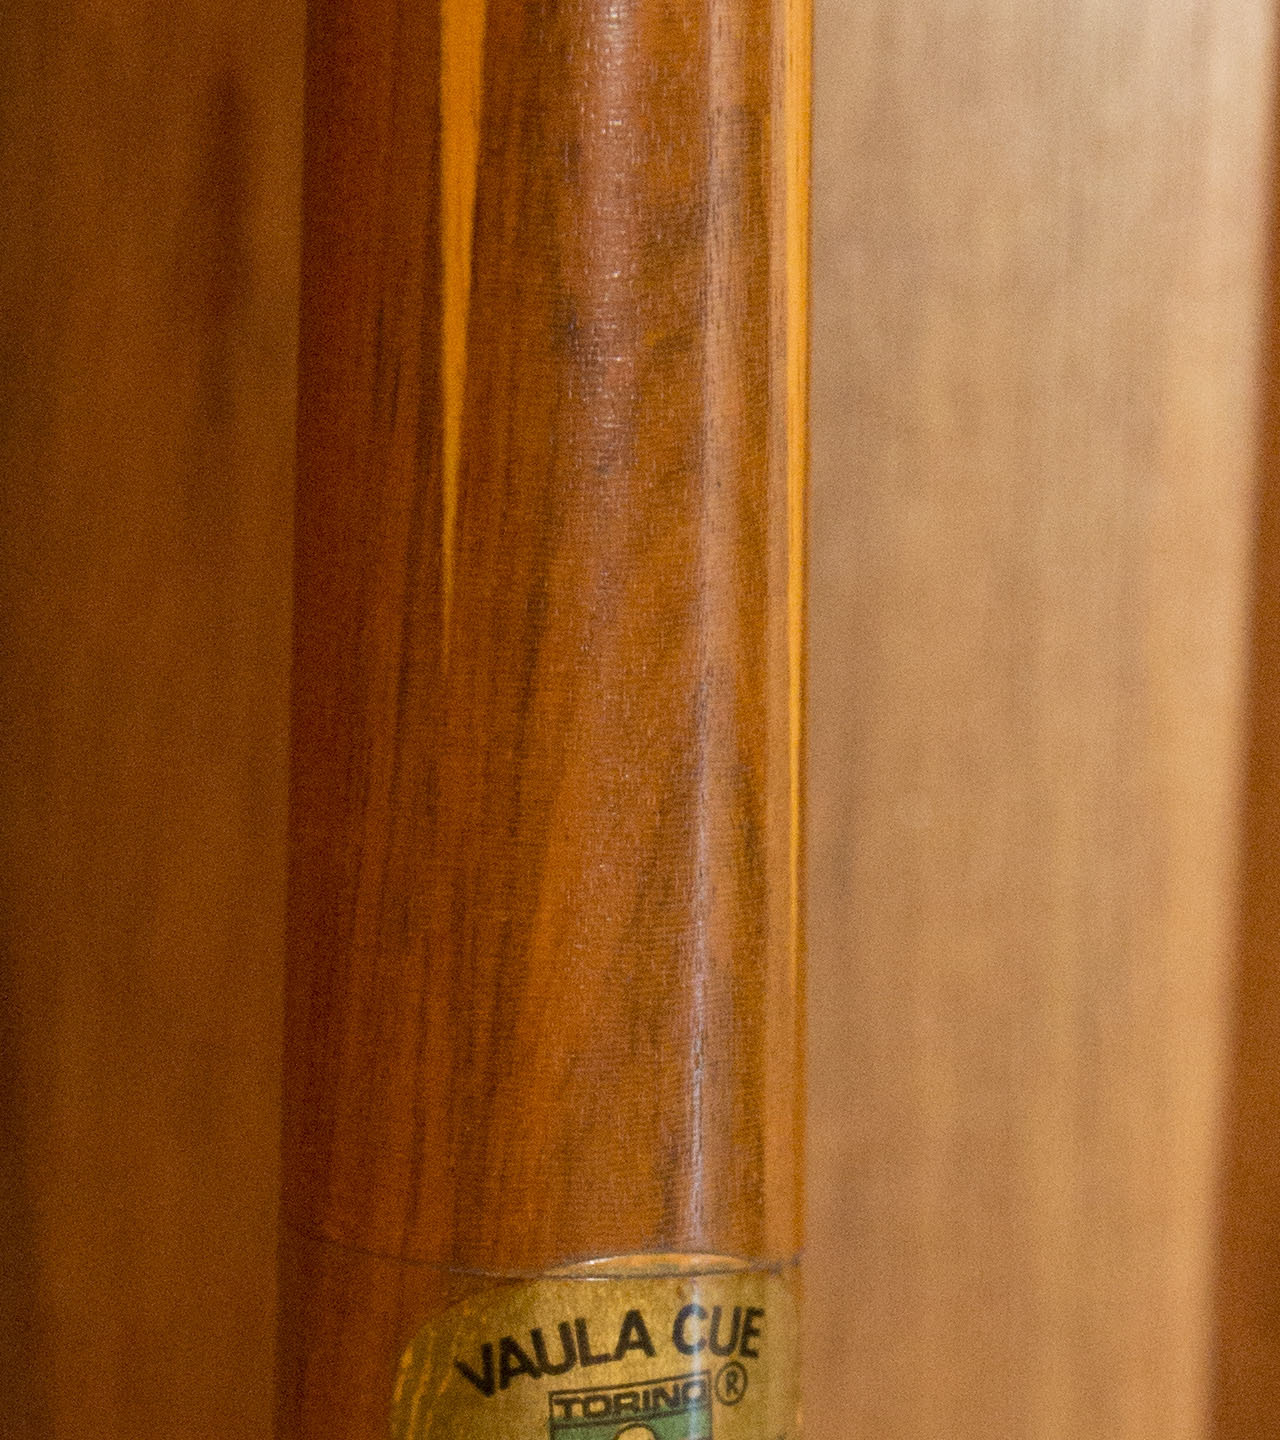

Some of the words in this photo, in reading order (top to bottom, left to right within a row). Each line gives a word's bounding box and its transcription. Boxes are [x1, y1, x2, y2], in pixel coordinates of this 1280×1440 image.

[453, 1308, 657, 1398] VAULA
[671, 1303, 765, 1359] CUE
[553, 1378, 708, 1419] TORINO
